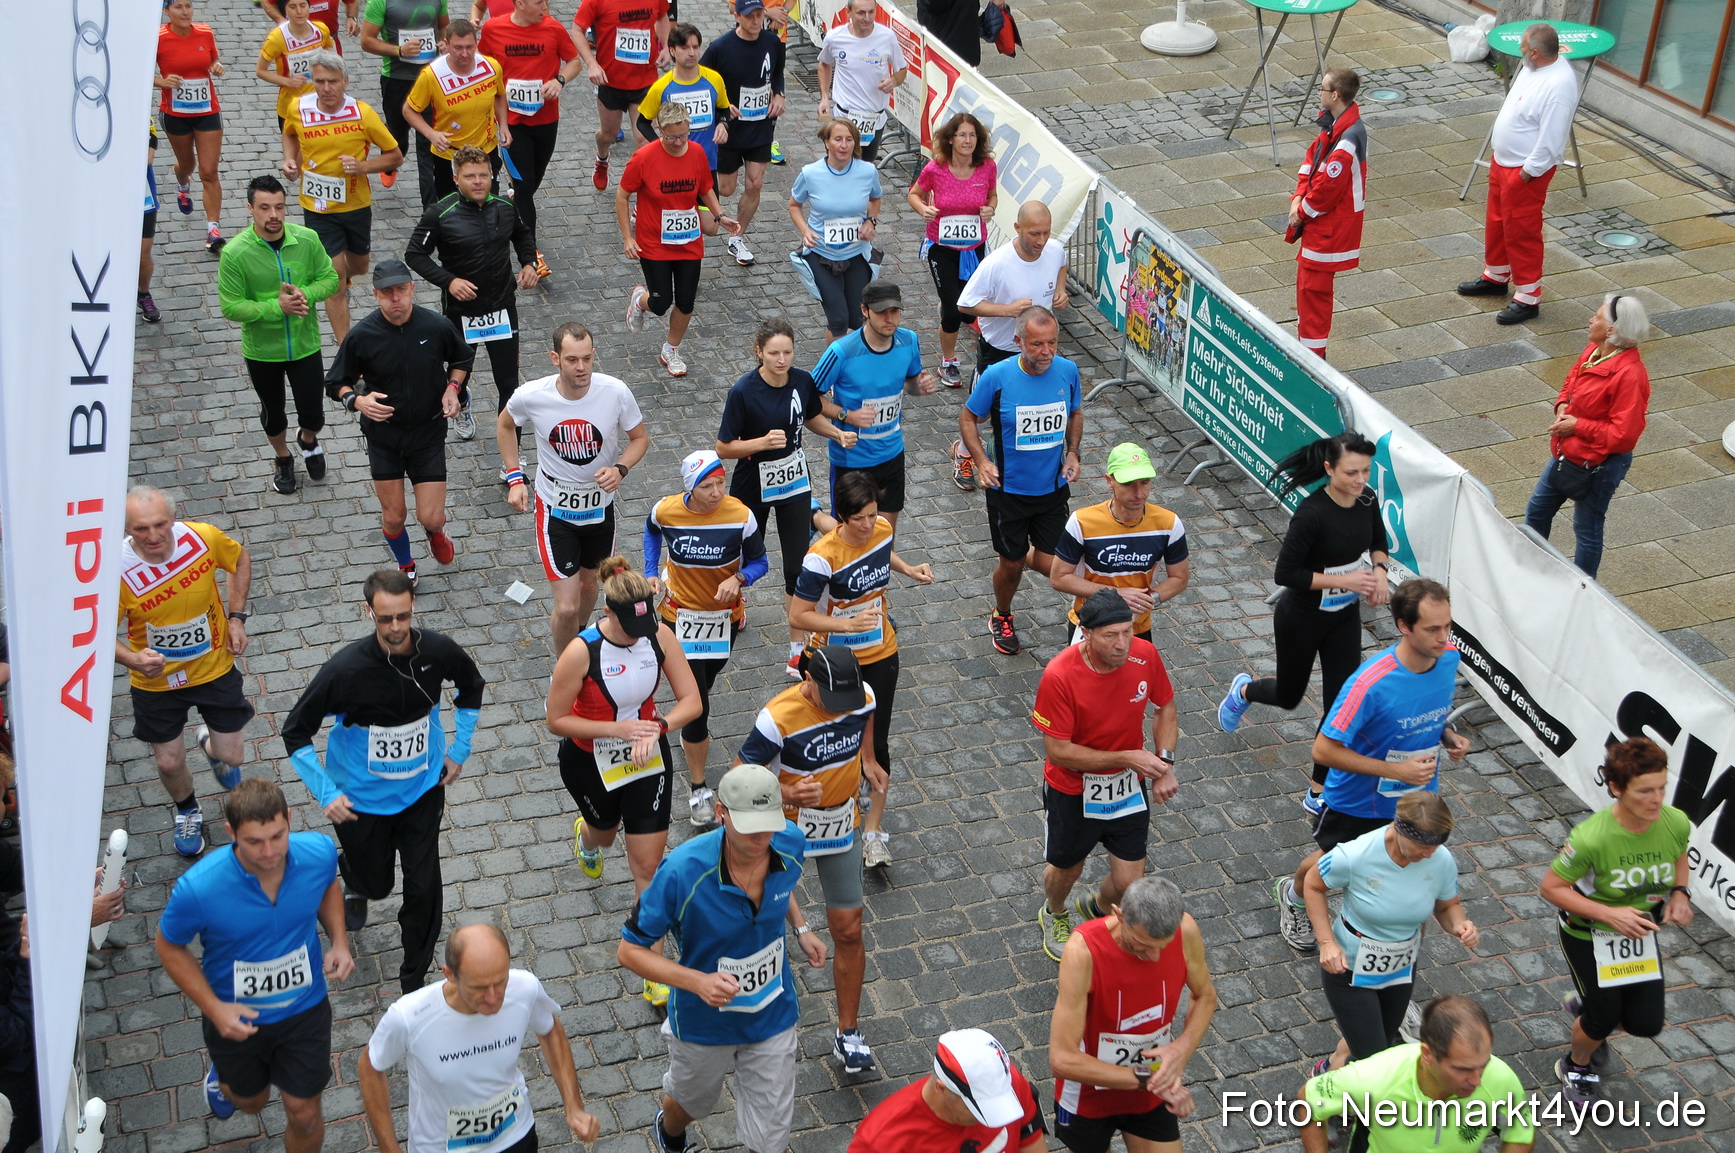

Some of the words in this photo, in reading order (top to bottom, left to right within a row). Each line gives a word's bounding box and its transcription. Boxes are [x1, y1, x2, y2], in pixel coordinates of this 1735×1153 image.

[420, 39, 434, 53] 25
[620, 37, 649, 51] 2018
[177, 87, 208, 101] 2518
[446, 93, 471, 107] MAX
[474, 80, 497, 96] BÖGL
[510, 88, 541, 102] 2011
[744, 93, 769, 109] 2188
[686, 100, 709, 116] 575
[304, 130, 330, 139] MAX
[334, 124, 365, 135] BÖGL
[307, 181, 341, 200] 2318
[666, 215, 698, 232] 2538
[943, 224, 977, 239] 2463
[829, 227, 860, 243] 2101
[1156, 266, 1175, 289] erdgas
[468, 312, 503, 328] 2387
[479, 328, 497, 337] Claus
[69, 249, 111, 456] BKK
[1215, 315, 1284, 382] Event-Leit-Systeme
[1192, 336, 1224, 370] Mehr
[1225, 366, 1284, 432] Sicherheit
[1036, 407, 1059, 415] Neumarkt
[1190, 362, 1208, 388] für
[1209, 380, 1226, 407] Ihr
[1228, 399, 1267, 445] Event!
[877, 405, 900, 423] 192
[1022, 414, 1062, 433] 2160
[1188, 398, 1205, 420] Miet
[1205, 414, 1211, 426] &
[1212, 419, 1237, 450] Service
[1237, 445, 1255, 467] Line:
[557, 423, 592, 443] TOKYO
[1029, 435, 1055, 444] Herbert
[556, 440, 598, 460] RUNNER
[766, 461, 804, 486] 2364
[558, 491, 601, 508] 2610
[560, 510, 596, 519] Alexander
[680, 543, 726, 555] Fischer
[1108, 552, 1153, 562] Fischer
[857, 563, 890, 588] Fischer
[139, 586, 179, 613] MAX
[178, 557, 215, 590] BÖGL
[62, 497, 106, 723] Audi
[677, 612, 697, 621] PARTL
[153, 627, 206, 648] 2228
[682, 621, 724, 639] 2771
[844, 635, 869, 644] Andrea
[167, 649, 197, 657] Johann
[694, 645, 711, 653] Katja
[1494, 674, 1510, 695] die
[1511, 689, 1560, 745] verbinden
[376, 732, 425, 759] 3378
[817, 731, 862, 758] Fischer
[822, 742, 860, 762] AUTOMOBILE
[608, 746, 632, 765] 28
[653, 775, 665, 811] orca
[1090, 773, 1133, 801] 2147
[805, 813, 852, 840] 2772
[811, 840, 849, 850] Friedrich
[1619, 851, 1662, 866] FÜRTH
[1609, 862, 1674, 889] 2012
[1360, 942, 1384, 954] PARTL
[1605, 937, 1644, 960] 180
[719, 962, 744, 971] PARTL
[746, 949, 775, 969] Neumarkt
[1610, 963, 1645, 977] Christine
[243, 964, 305, 997] 3405
[439, 1035, 518, 1062] www.hasit.de
[449, 1109, 476, 1117] PARTL
